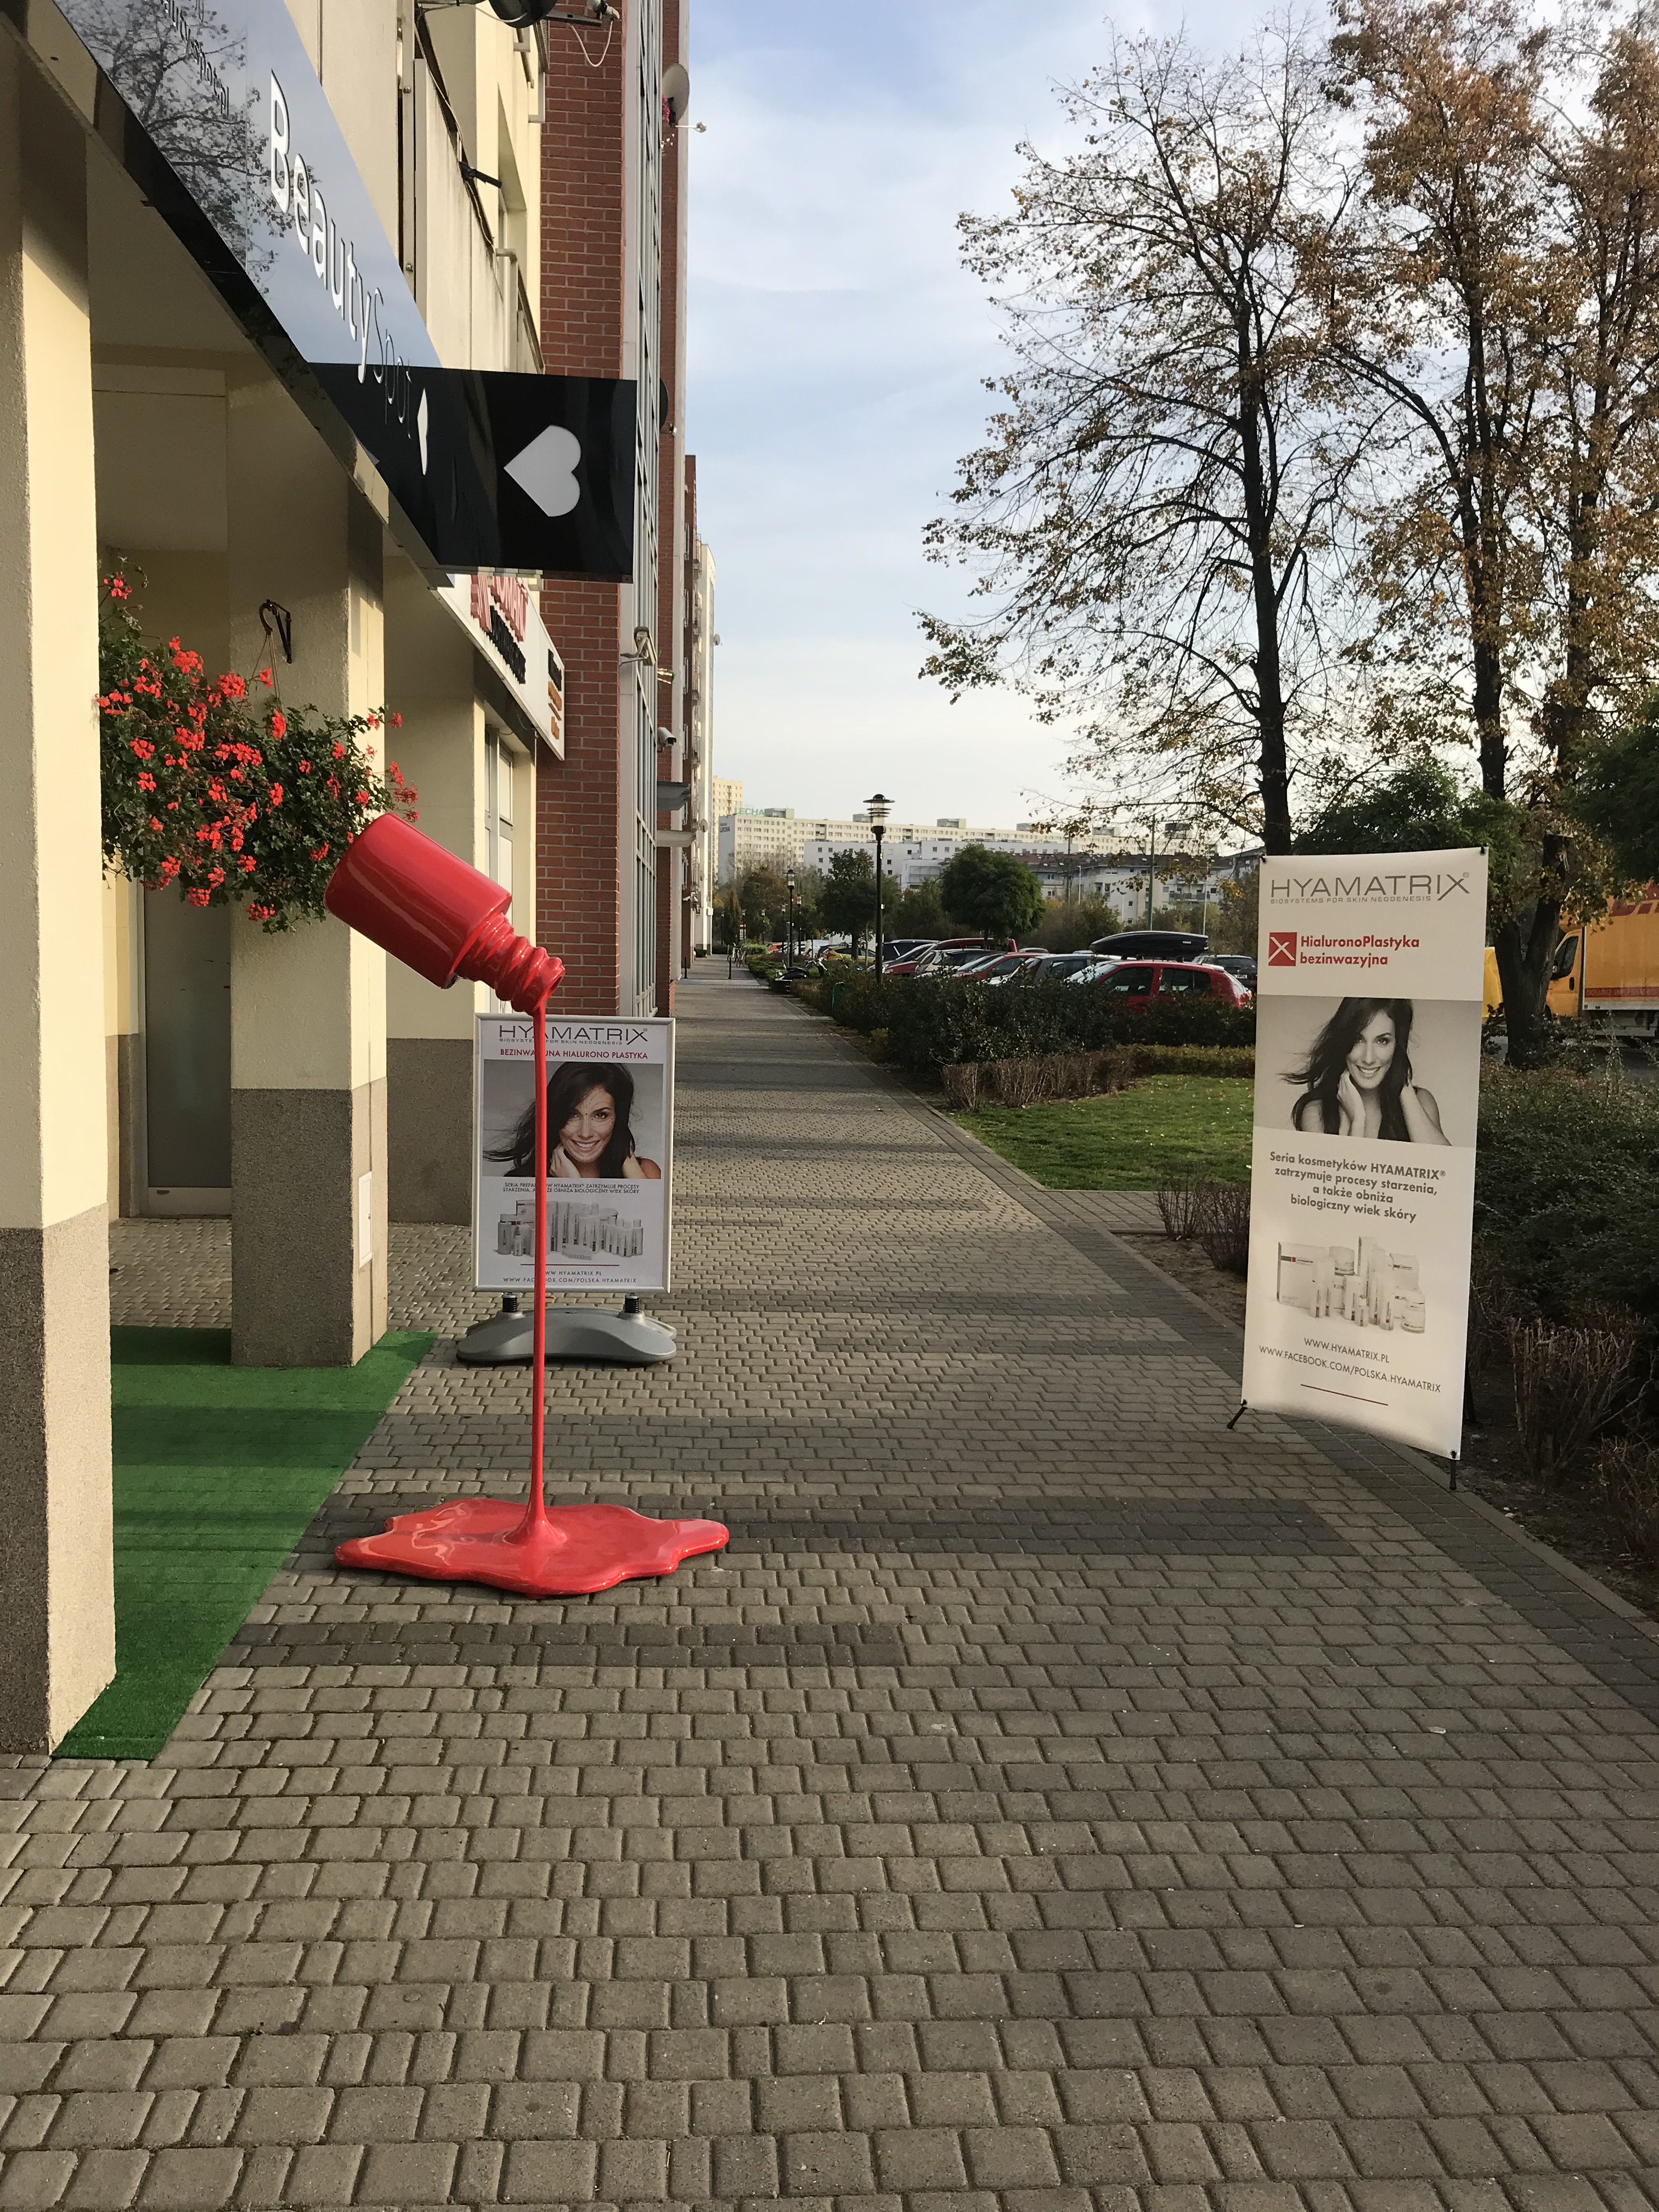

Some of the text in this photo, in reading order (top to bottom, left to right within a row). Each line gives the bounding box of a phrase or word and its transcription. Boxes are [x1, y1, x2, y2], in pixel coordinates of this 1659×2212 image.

[734, 808, 765, 816] LECHA
[1271, 873, 1470, 901] HYAMATRIX
[1301, 935, 1419, 951] HialuronoPlastyka
[1300, 952, 1388, 968] bezinwazyjna
[500, 1048, 561, 1057] BEZINWAJNA
[563, 1050, 610, 1058] HIALURONO
[1270, 1152, 1295, 1163] Seria
[1298, 1154, 1367, 1172] kosmetyków
[1275, 1167, 1437, 1196] zatrzymuje procesy starzenia,
[1323, 1186, 1352, 1198] także
[1356, 1189, 1393, 1203] obniża
[1290, 1194, 1417, 1223] biologiczny wiek skóry
[1304, 1338, 1390, 1363] WWW.HYAMATRIX.PL
